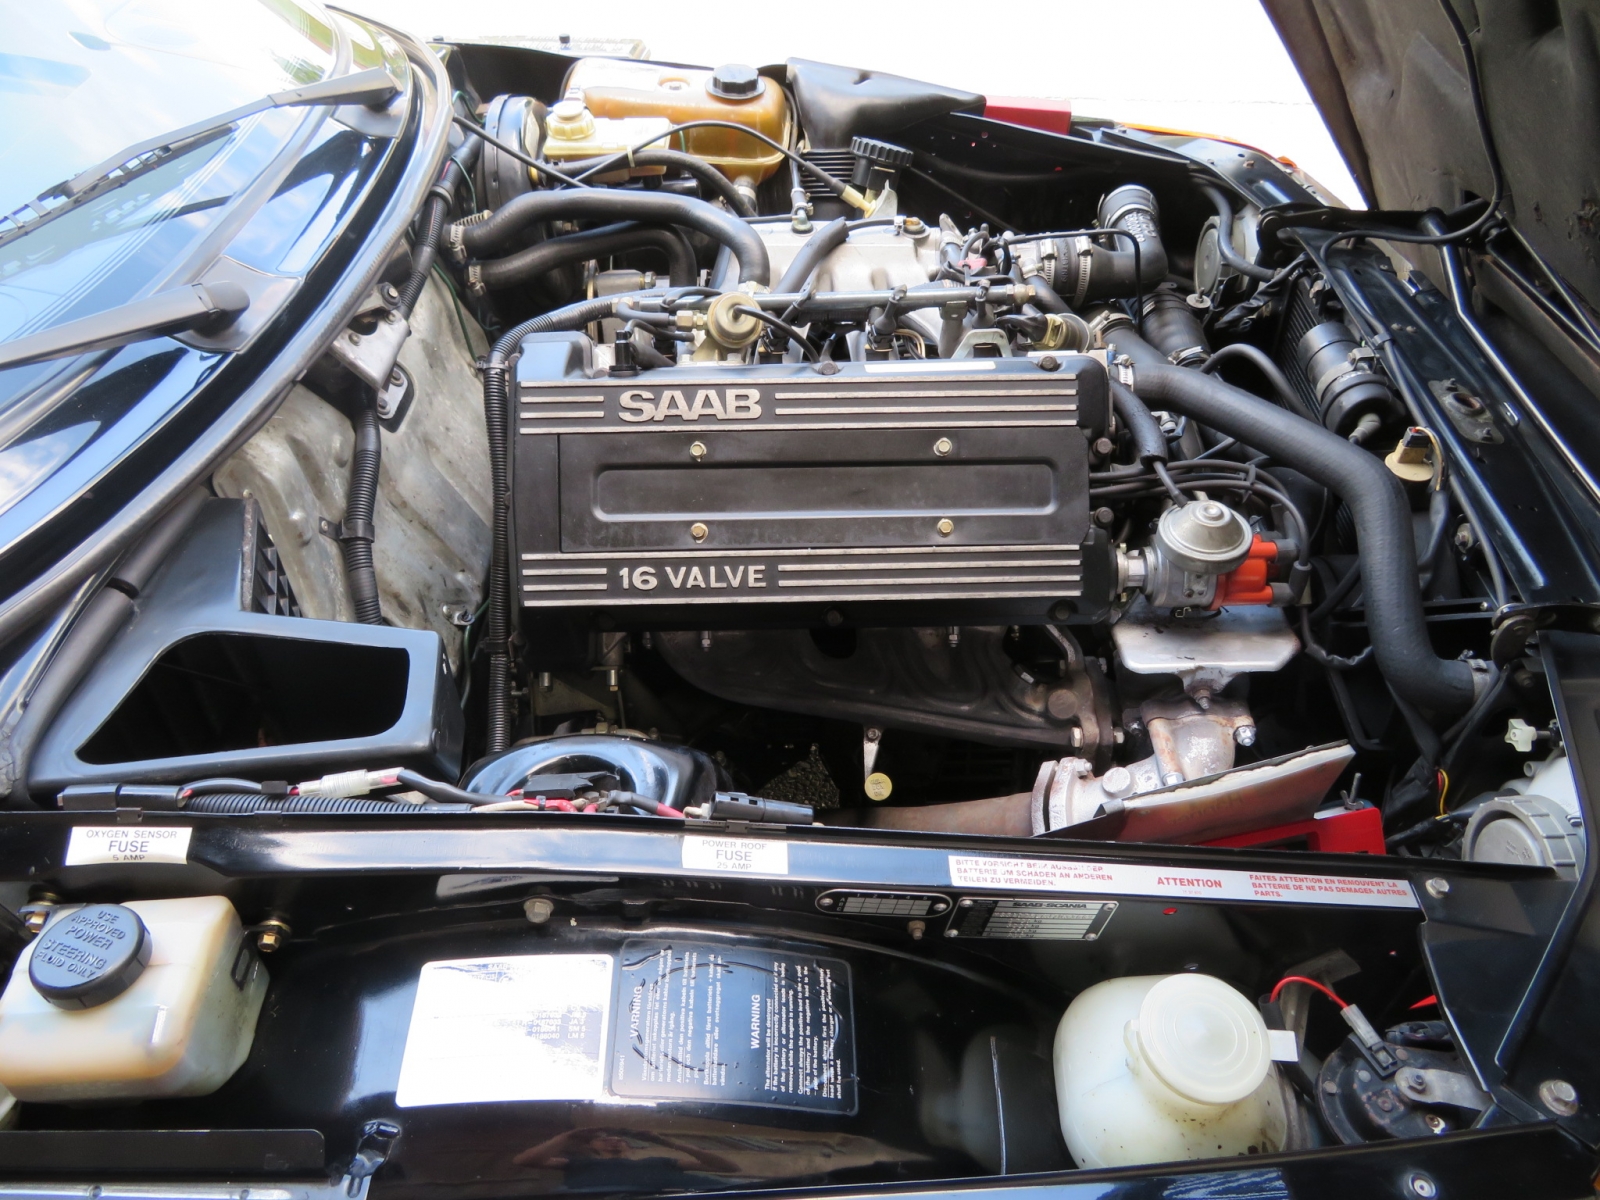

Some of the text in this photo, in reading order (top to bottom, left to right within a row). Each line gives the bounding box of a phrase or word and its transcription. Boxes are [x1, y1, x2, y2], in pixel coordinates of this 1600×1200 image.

[618, 388, 762, 422] SAAB
[619, 565, 766, 591] 16 VALVE
[86, 829, 177, 839] OXYGEN SENSOR
[108, 840, 150, 853] FUSE
[702, 839, 767, 850] POWER ROOF
[716, 849, 752, 861] FUSE
[731, 862, 752, 870] AMP
[956, 868, 998, 876] BATTERIE
[1016, 870, 1057, 878] SCHADEN
[1157, 877, 1222, 888] ATTENTION
[1252, 882, 1291, 890] BATTERIE
[1335, 886, 1374, 894] DEMAGER
[1280, 876, 1323, 884] ATTENTION
[1338, 879, 1385, 887] REMOUVENT
[1254, 890, 1283, 898] PARTS.
[97, 910, 120, 924] USE
[71, 915, 126, 940] APPROVED
[65, 925, 114, 951] POWER
[43, 938, 107, 970] STEERING
[35, 951, 96, 979] FLUID ONLY
[630, 986, 642, 1037] VARNING
[750, 994, 760, 1049] WARNING
